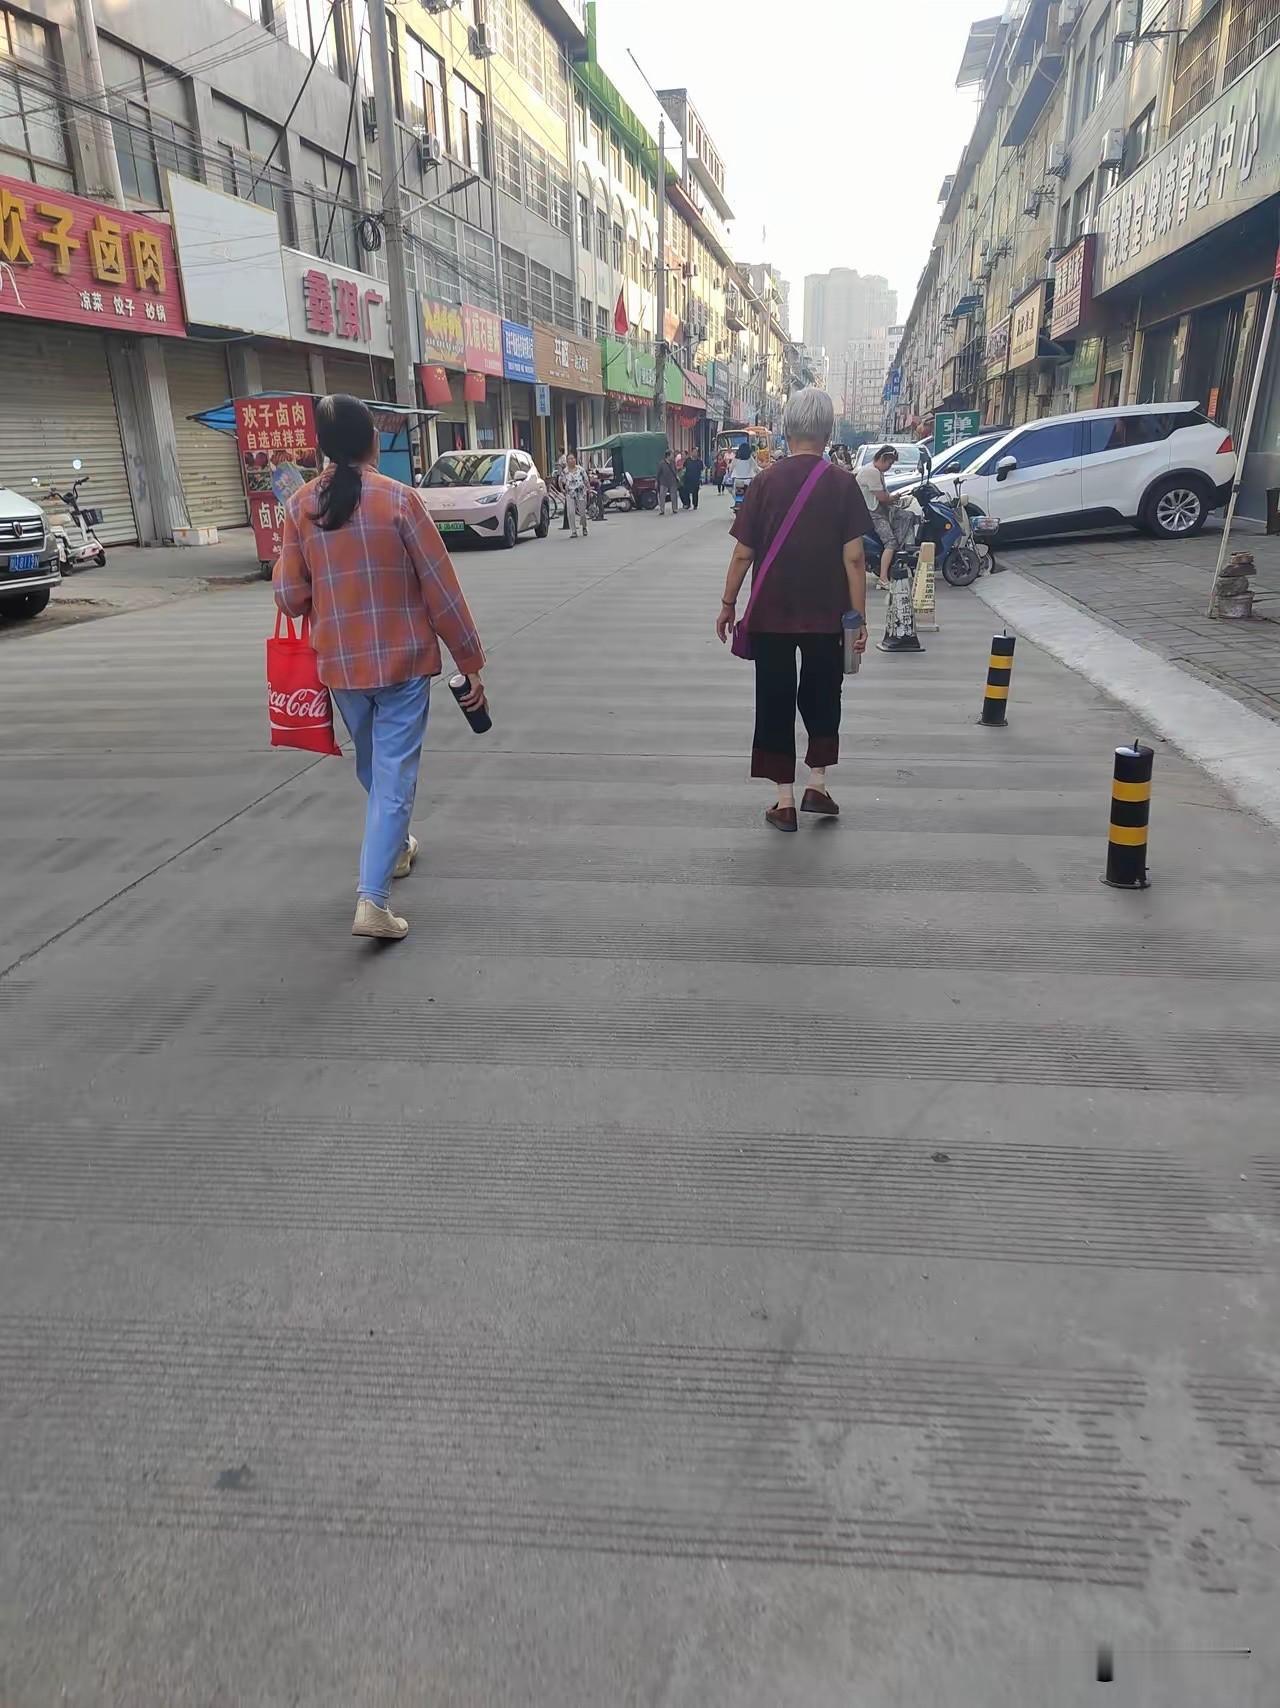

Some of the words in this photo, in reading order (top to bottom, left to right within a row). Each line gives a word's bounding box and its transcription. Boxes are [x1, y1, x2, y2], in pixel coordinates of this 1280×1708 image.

[79, 291, 104, 312] 凉菜
[113, 295, 136, 317] 饺子
[144, 302, 167, 323] 砂锅
[242, 401, 307, 428] 欢子卤肉
[246, 429, 308, 450] 自选凉拌菜
